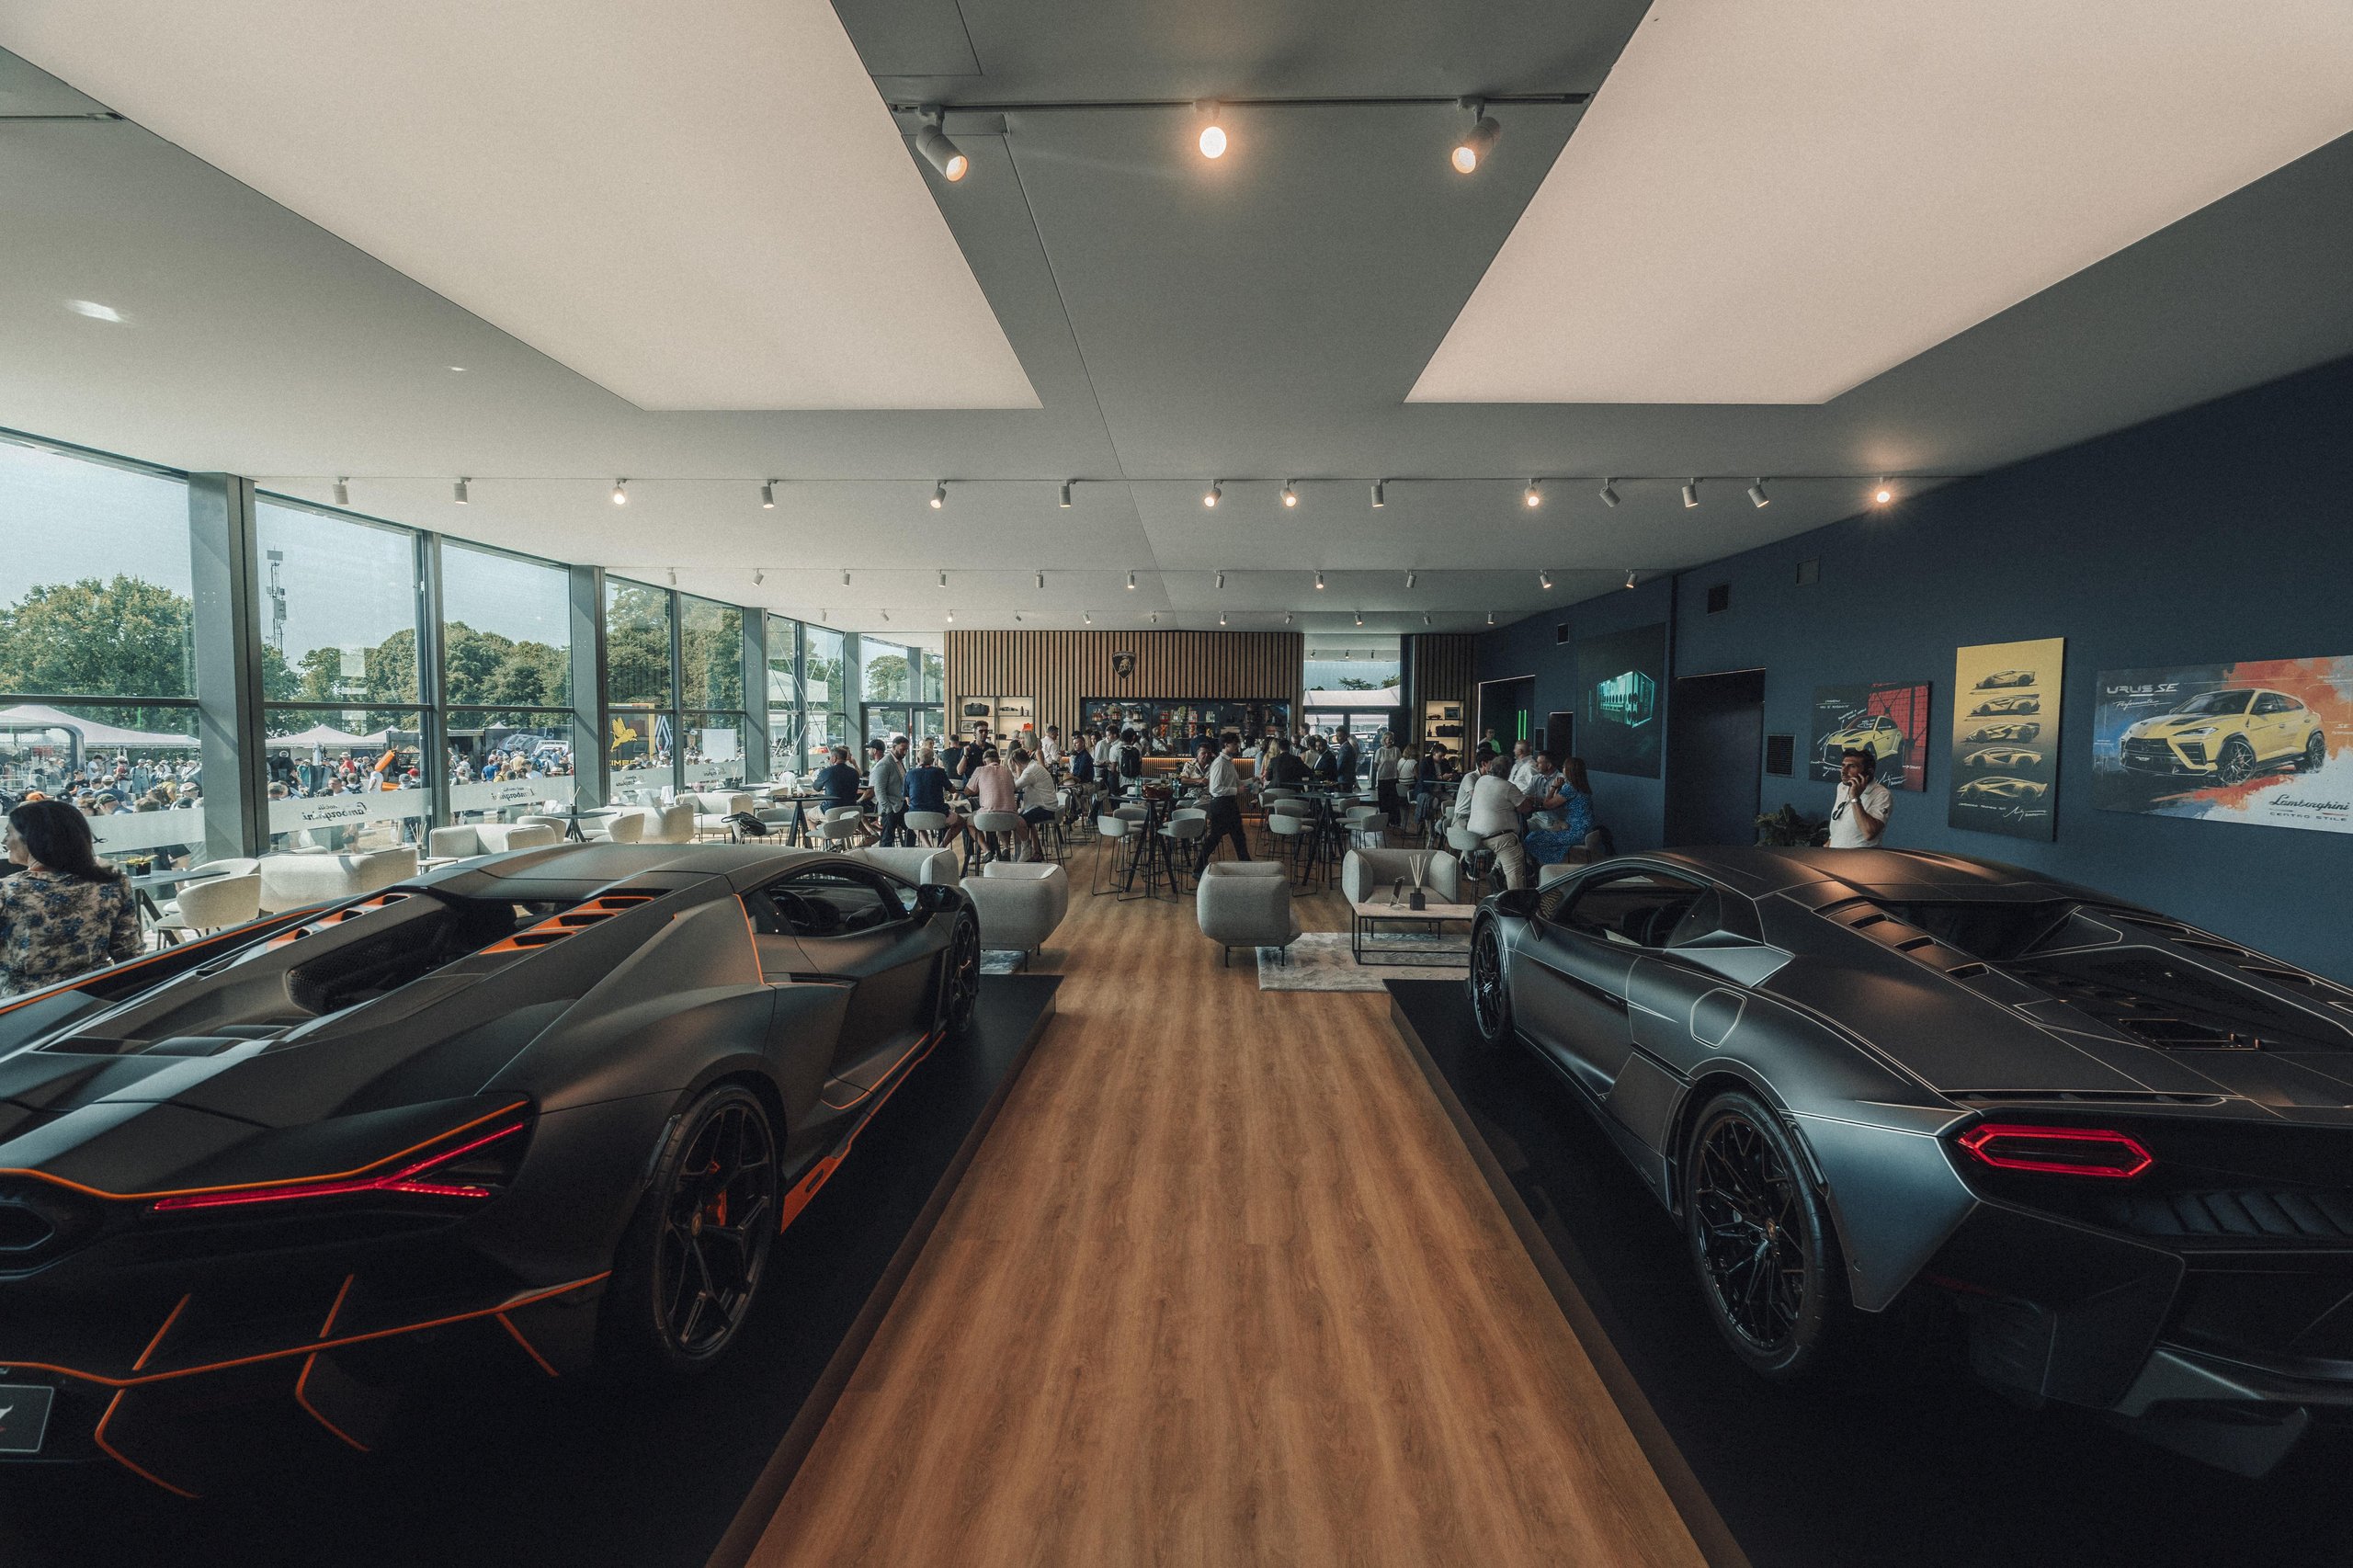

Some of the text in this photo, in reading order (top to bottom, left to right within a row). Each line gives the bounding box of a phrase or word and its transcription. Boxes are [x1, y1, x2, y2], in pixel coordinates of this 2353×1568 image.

[2107, 682, 2180, 694] URUS SE
[2268, 793, 2351, 811] Lamborghini
